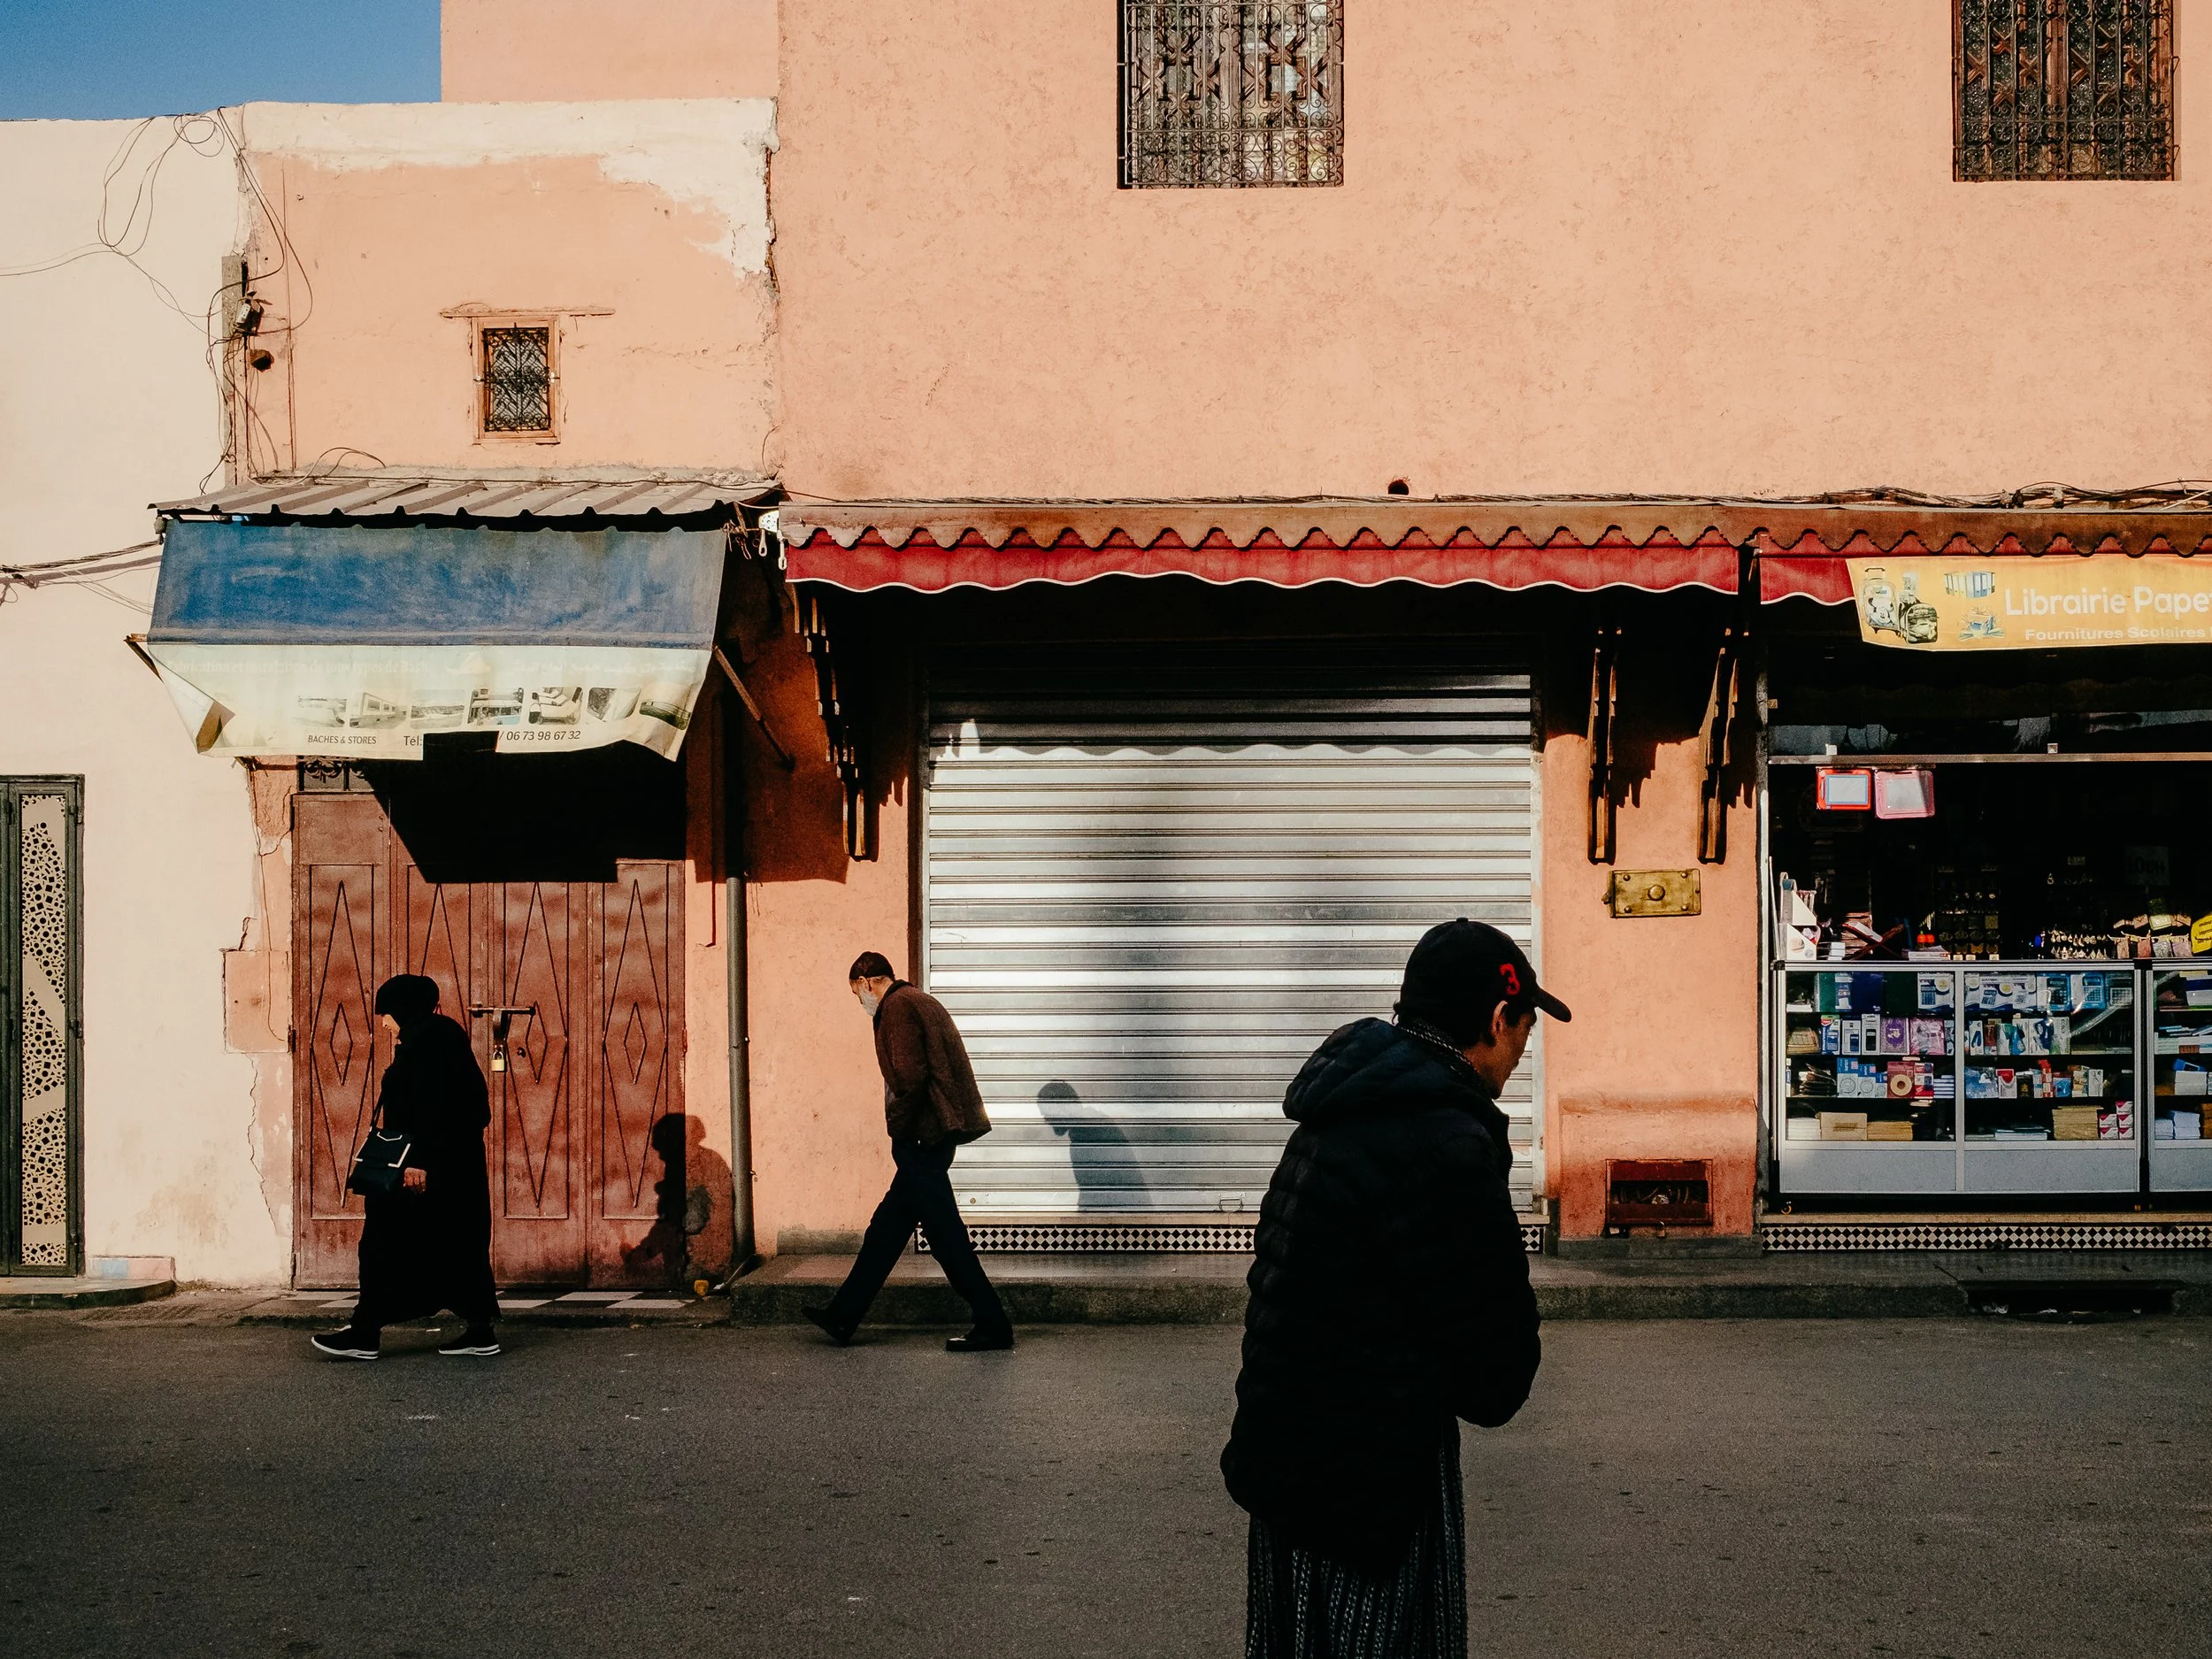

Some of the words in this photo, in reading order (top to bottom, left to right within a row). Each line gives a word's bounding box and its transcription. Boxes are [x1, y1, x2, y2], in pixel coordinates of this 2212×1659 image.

[2005, 588, 2127, 616] Librairie
[2134, 586, 2212, 619] Pape
[2025, 627, 2124, 641] Fournitures
[2127, 626, 2206, 639] Scolaires
[308, 734, 339, 744] BACHES
[340, 735, 347, 744] &
[348, 735, 377, 745] STORES
[403, 734, 423, 747] Tél:
[506, 731, 520, 741] 06
[523, 731, 535, 741] 73
[537, 731, 551, 741] 98
[553, 731, 567, 741] 67
[568, 730, 581, 740] 32
[1499, 963, 1521, 995] 3
